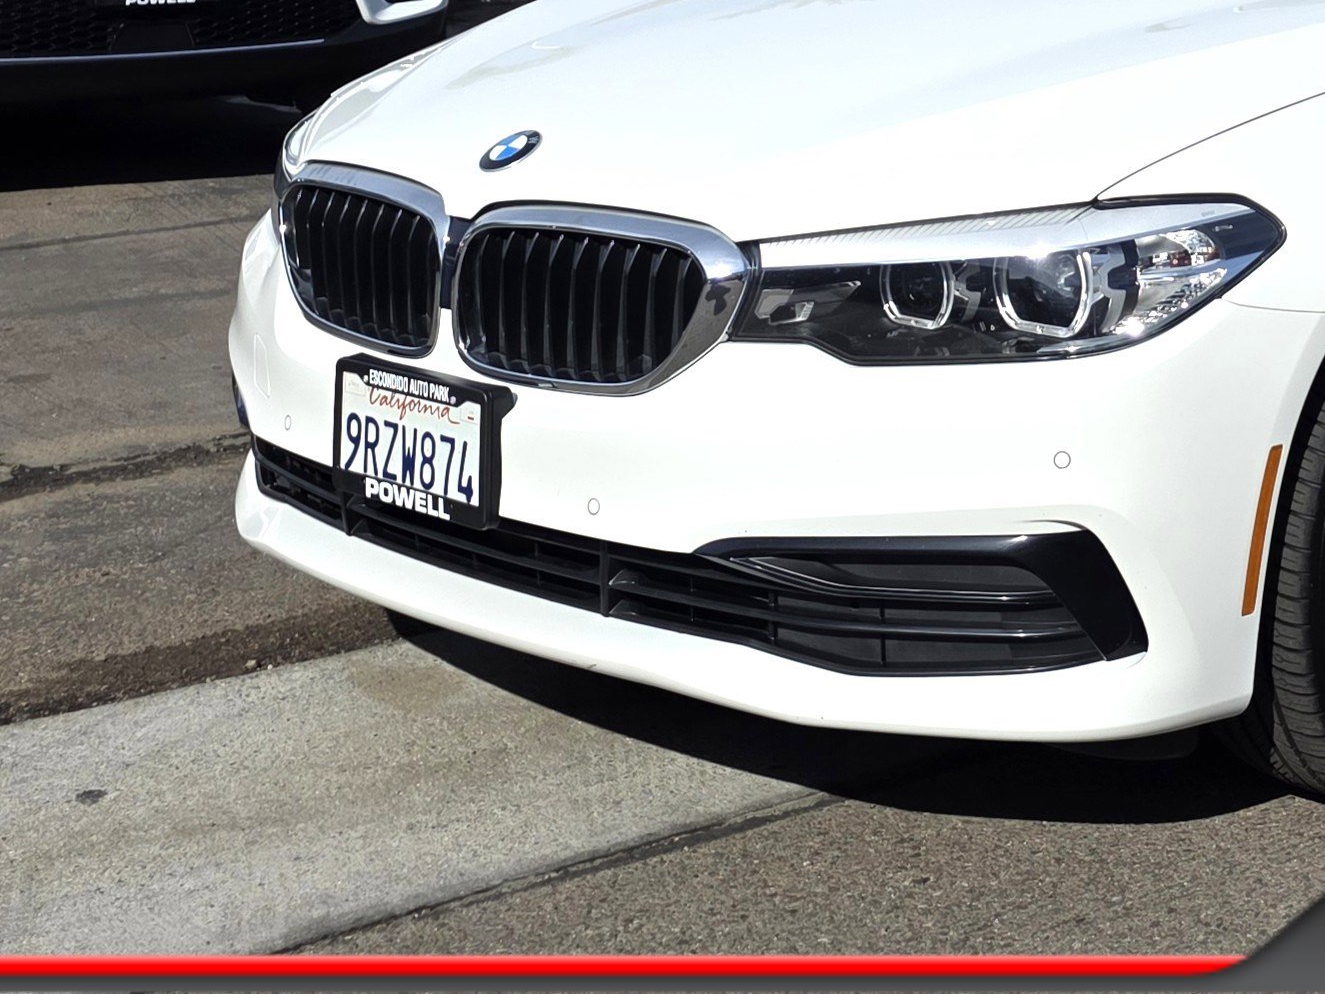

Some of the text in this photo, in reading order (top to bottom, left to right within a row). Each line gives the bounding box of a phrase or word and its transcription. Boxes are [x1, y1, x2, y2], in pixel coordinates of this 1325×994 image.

[369, 369, 450, 402] ESCONDIDO AUTO PARK
[369, 385, 460, 424] California
[344, 412, 474, 504] 9RZW874
[364, 477, 451, 521] POWELL
